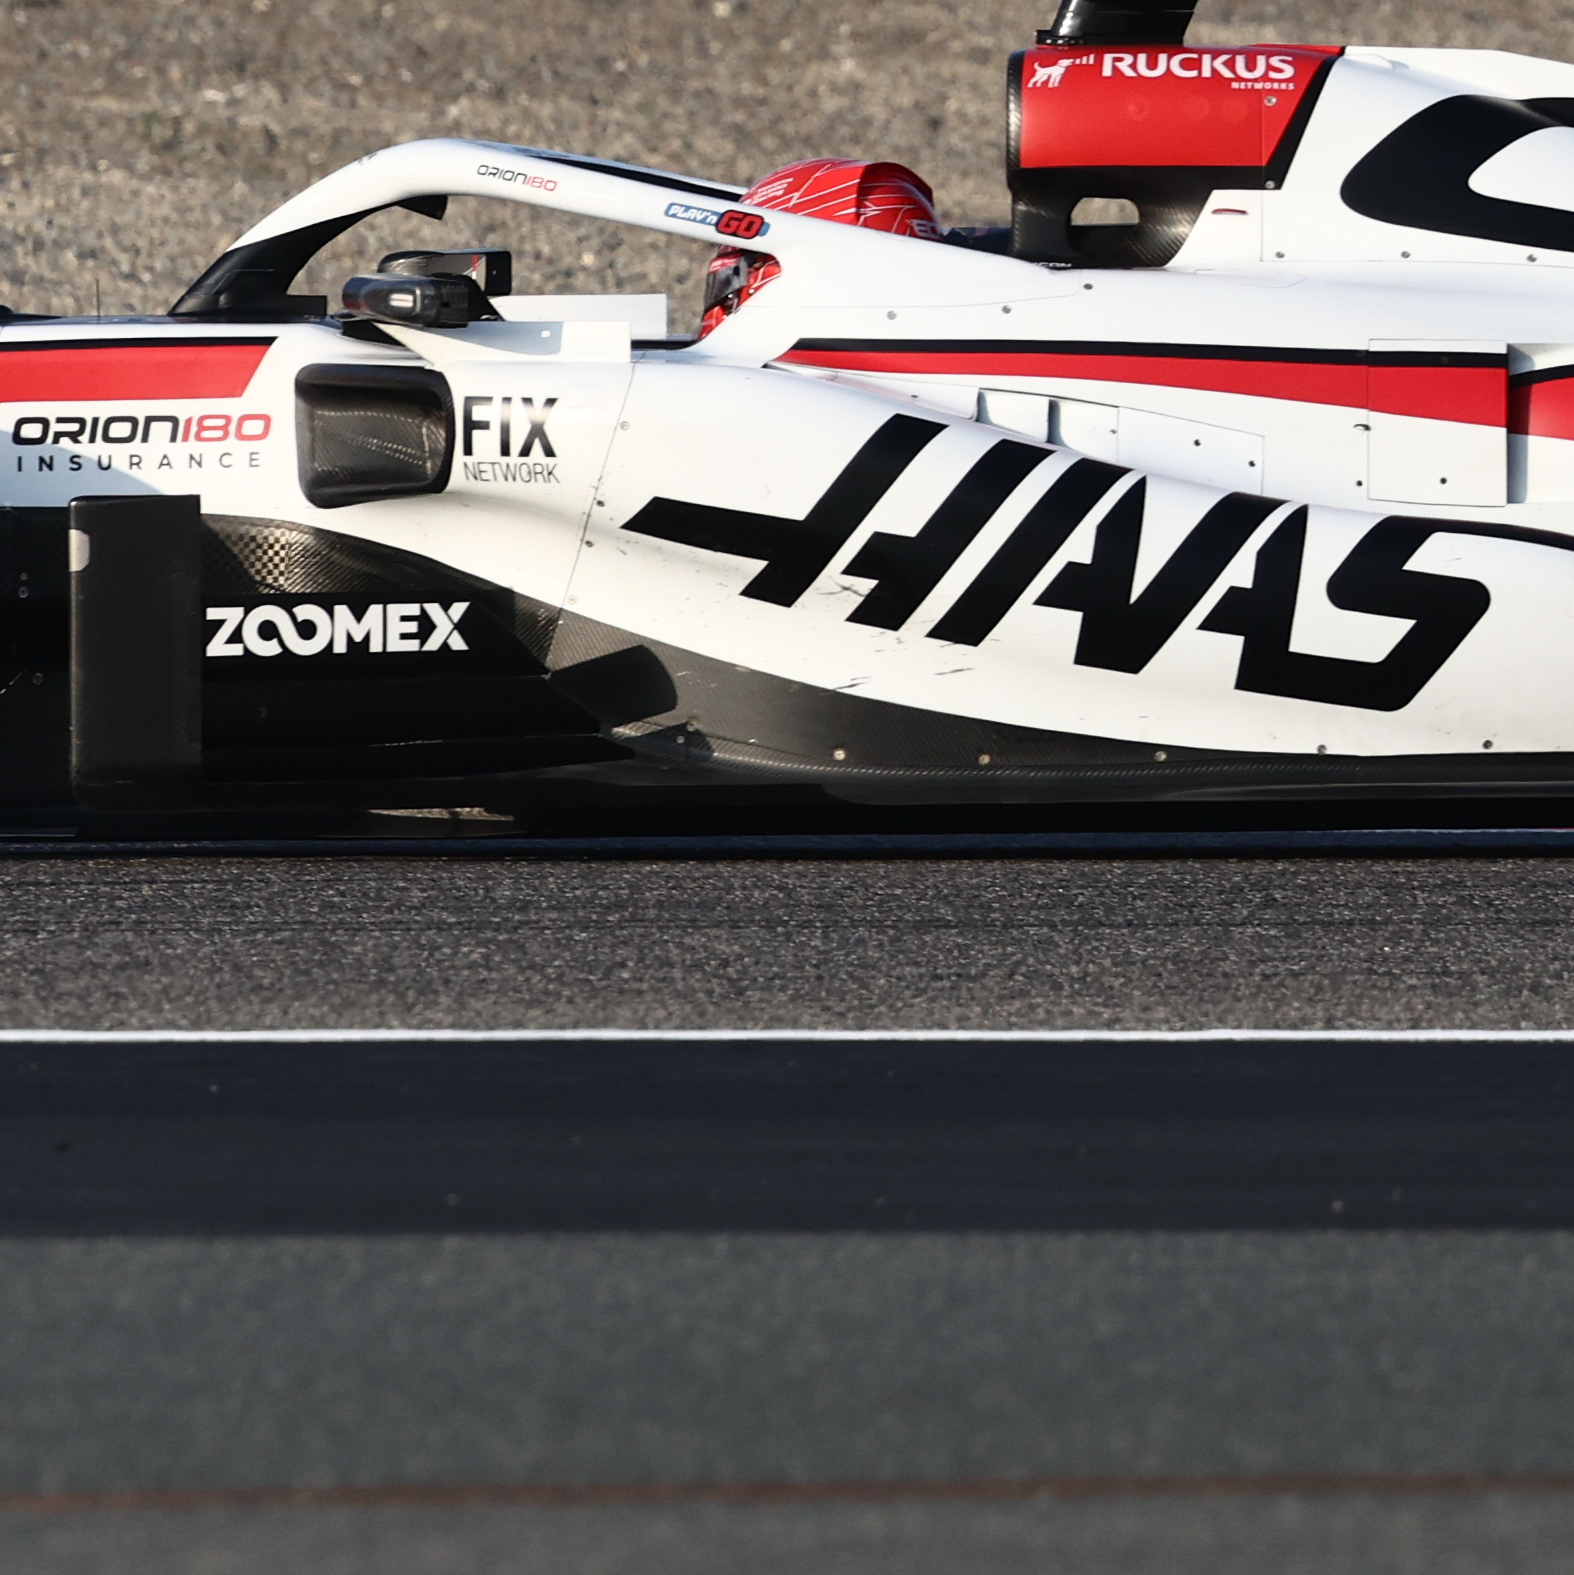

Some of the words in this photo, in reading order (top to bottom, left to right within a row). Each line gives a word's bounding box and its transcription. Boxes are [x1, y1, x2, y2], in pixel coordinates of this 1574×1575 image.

[1101, 52, 1295, 80] RUCKUS
[1230, 81, 1295, 90] NETWORKS
[477, 164, 558, 192] ORION180
[717, 211, 764, 239] GO
[12, 413, 272, 447] ORION180
[463, 396, 560, 458] FIX
[16, 451, 262, 473] INSURANCE
[463, 461, 561, 485] NETWORK
[204, 601, 471, 657] ZOOMEX
